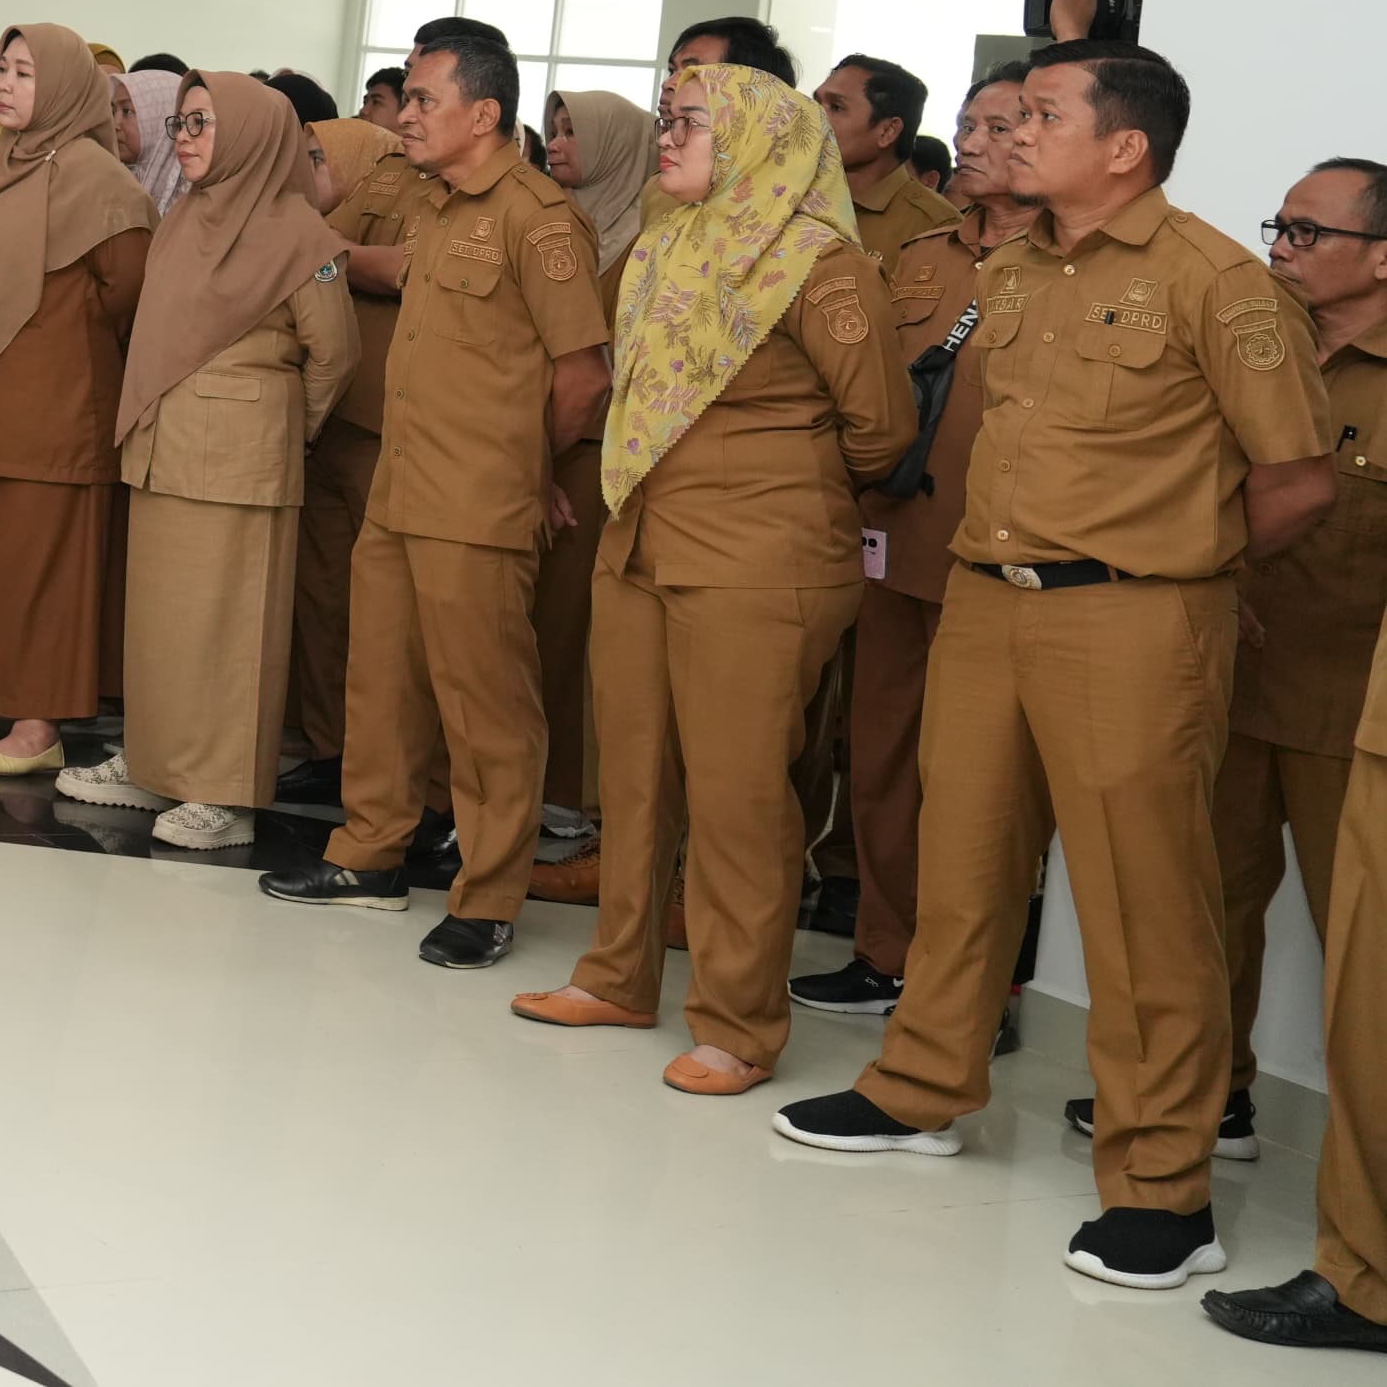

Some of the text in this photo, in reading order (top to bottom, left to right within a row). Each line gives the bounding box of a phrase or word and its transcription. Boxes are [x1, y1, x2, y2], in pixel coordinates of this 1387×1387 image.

[473, 247, 499, 261] DPRD
[942, 299, 979, 352] HEN
[1121, 311, 1163, 329] DPRD
